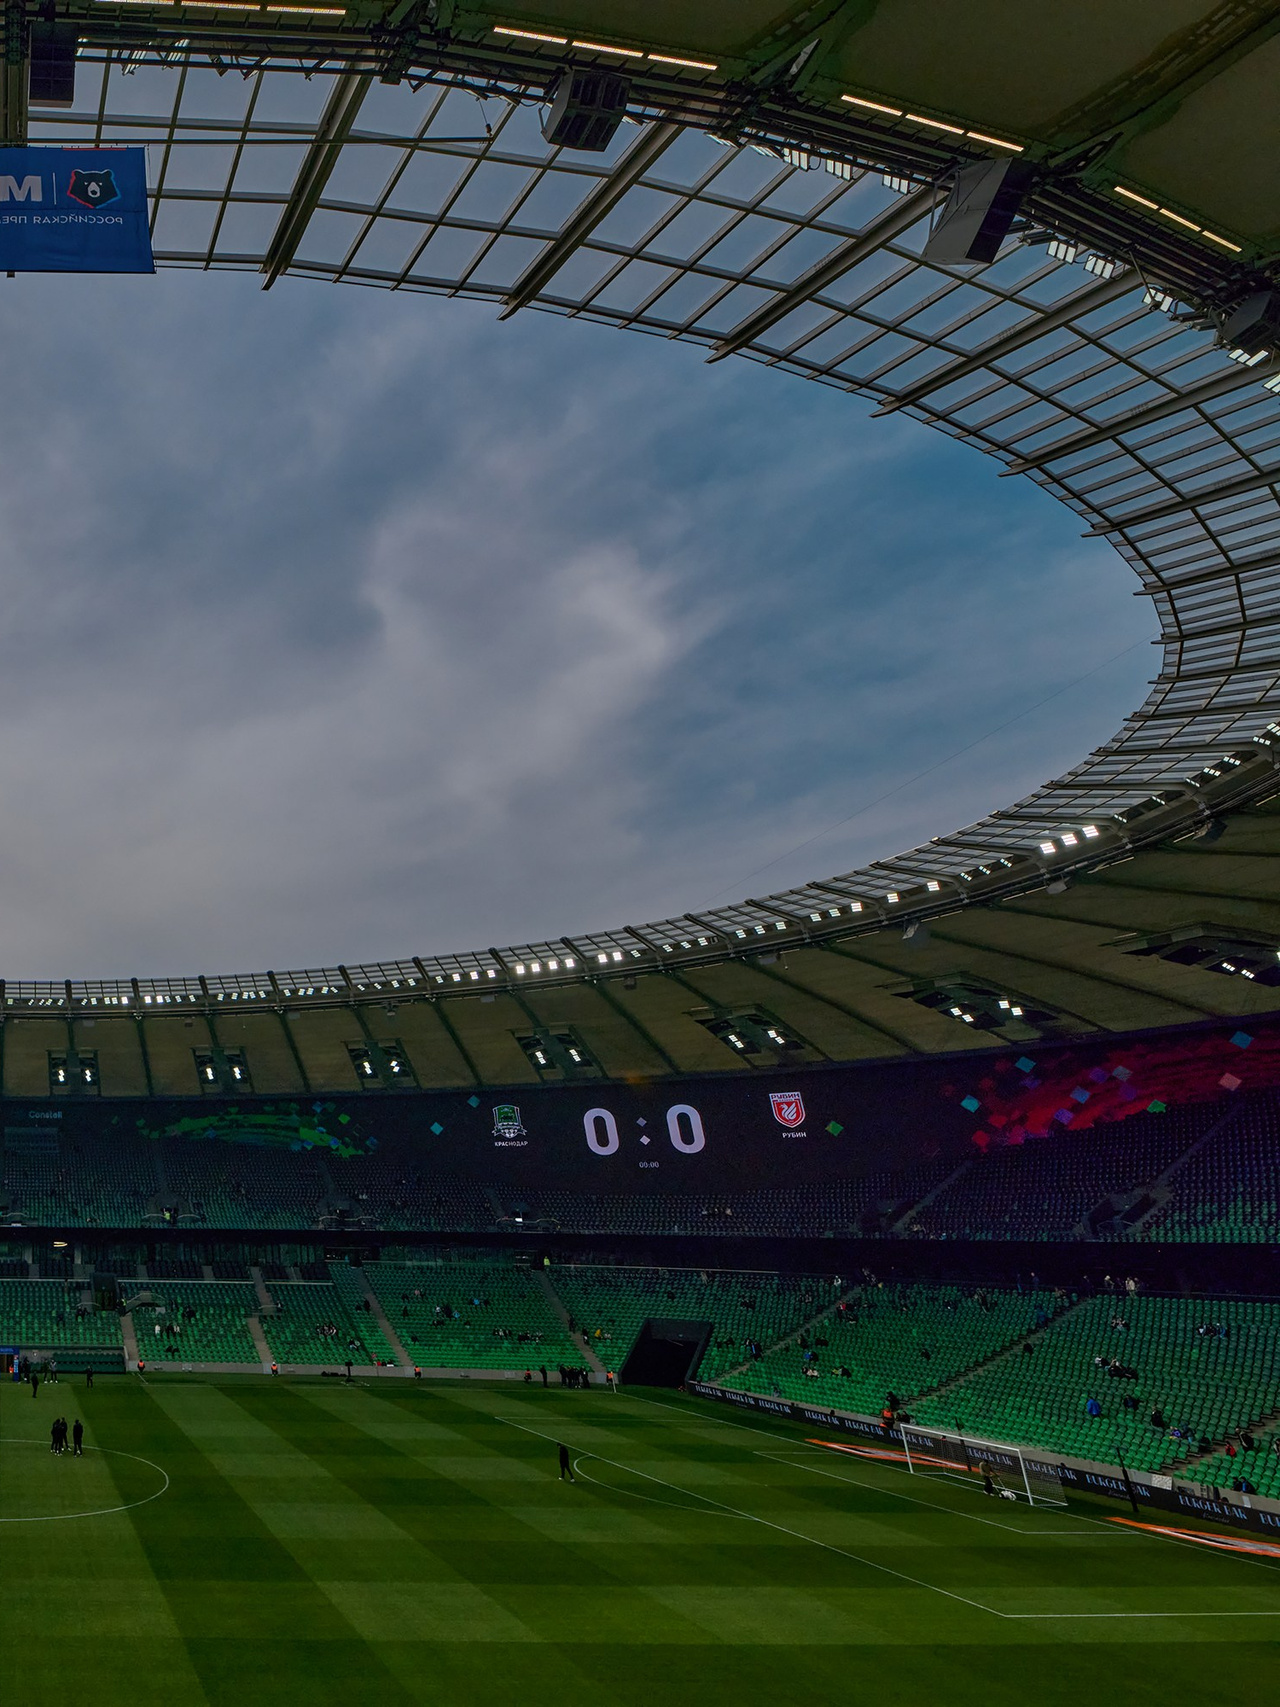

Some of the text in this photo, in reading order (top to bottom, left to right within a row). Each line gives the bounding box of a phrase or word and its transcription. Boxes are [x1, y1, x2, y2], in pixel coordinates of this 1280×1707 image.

[583, 1104, 706, 1156] 0 0
[1085, 1473, 1127, 1492] BURGER
[1178, 1494, 1221, 1515] BURGER
[1223, 1504, 1248, 1520] BAR
